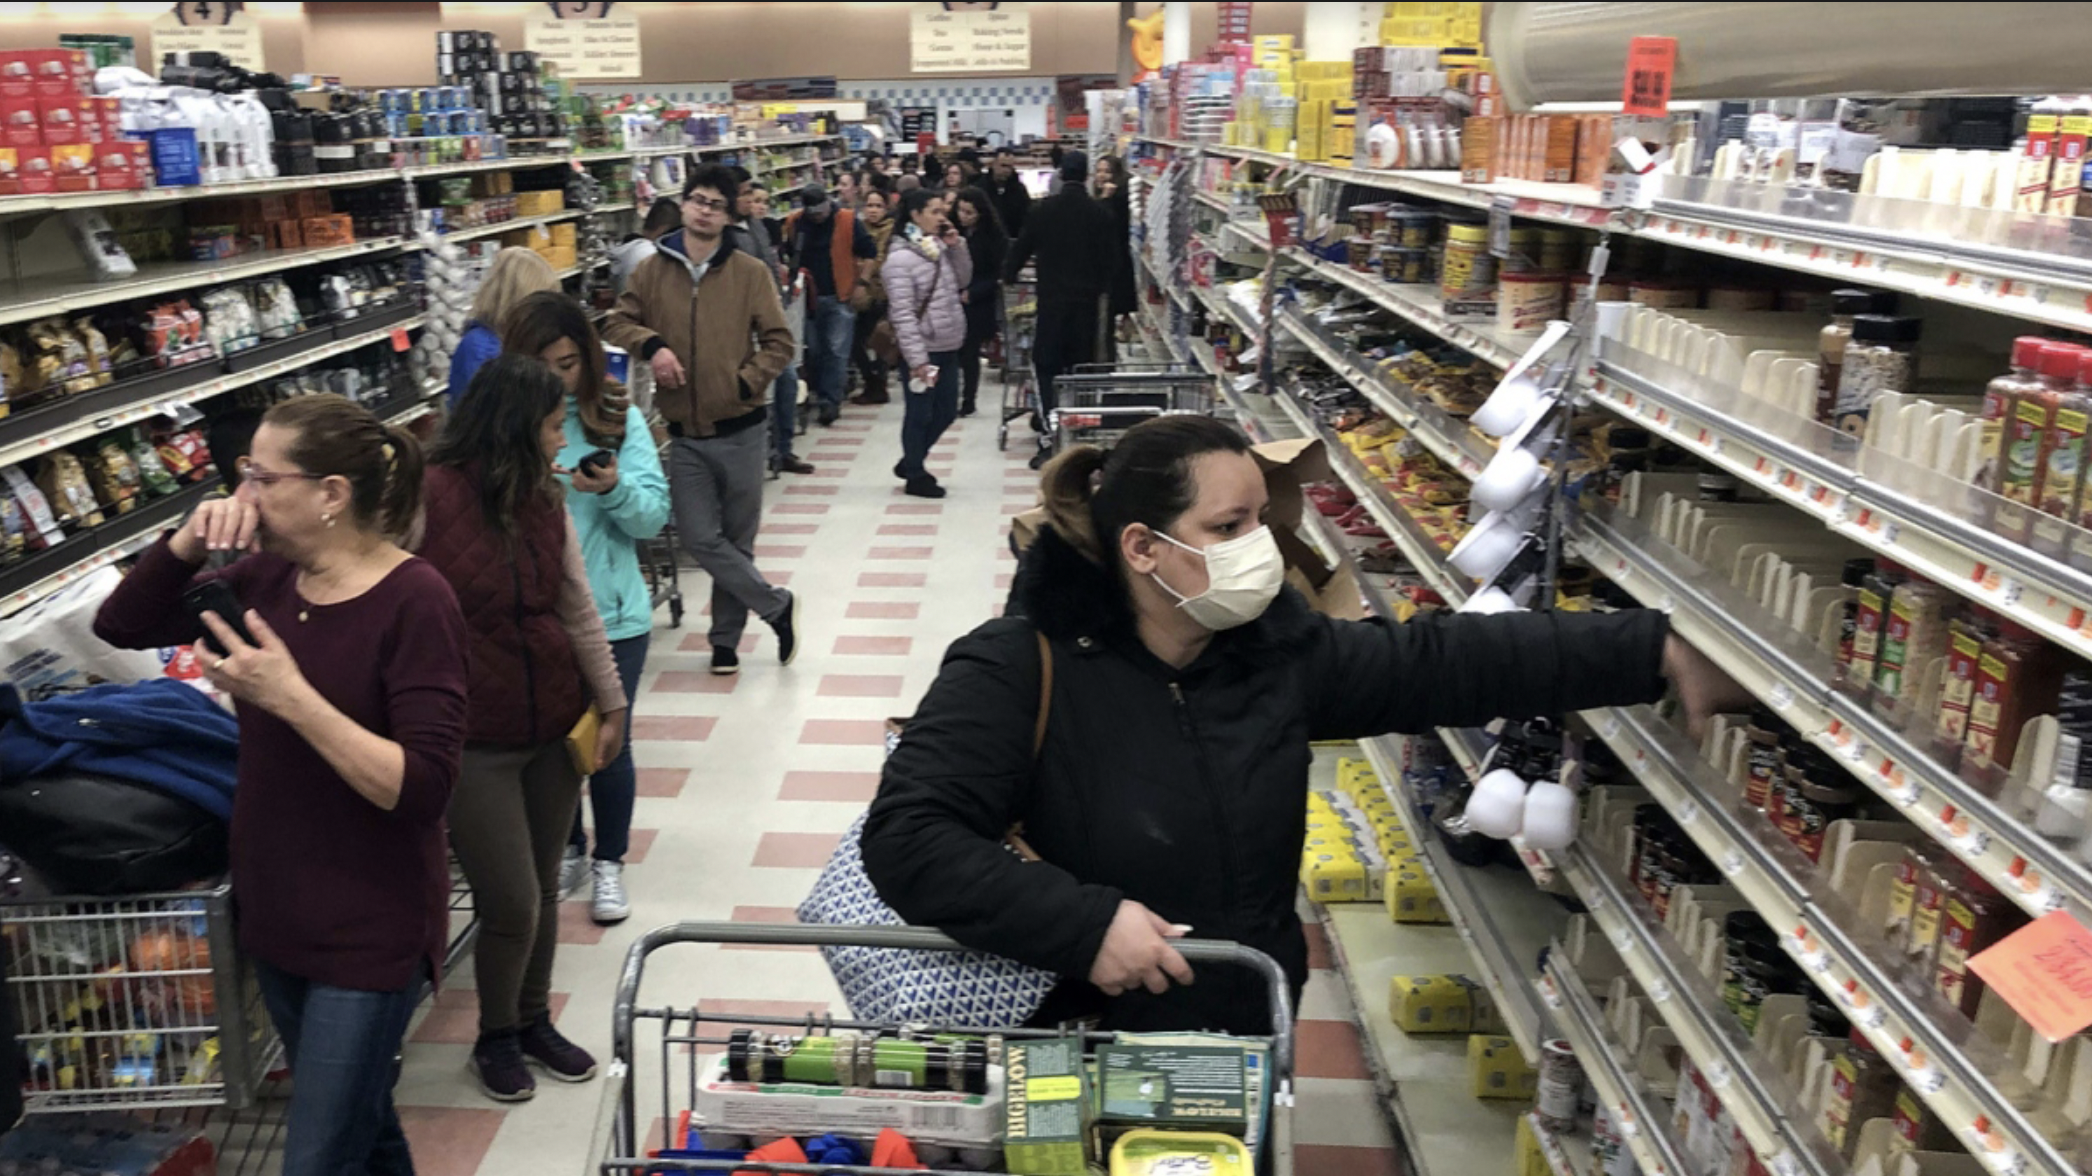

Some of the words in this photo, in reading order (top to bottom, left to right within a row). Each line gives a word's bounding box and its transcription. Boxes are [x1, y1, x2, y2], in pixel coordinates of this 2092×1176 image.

[195, 2, 211, 19] 4
[1006, 1046, 1027, 1138] BIGELOW
[1171, 1107, 1243, 1117] BIGELOW
